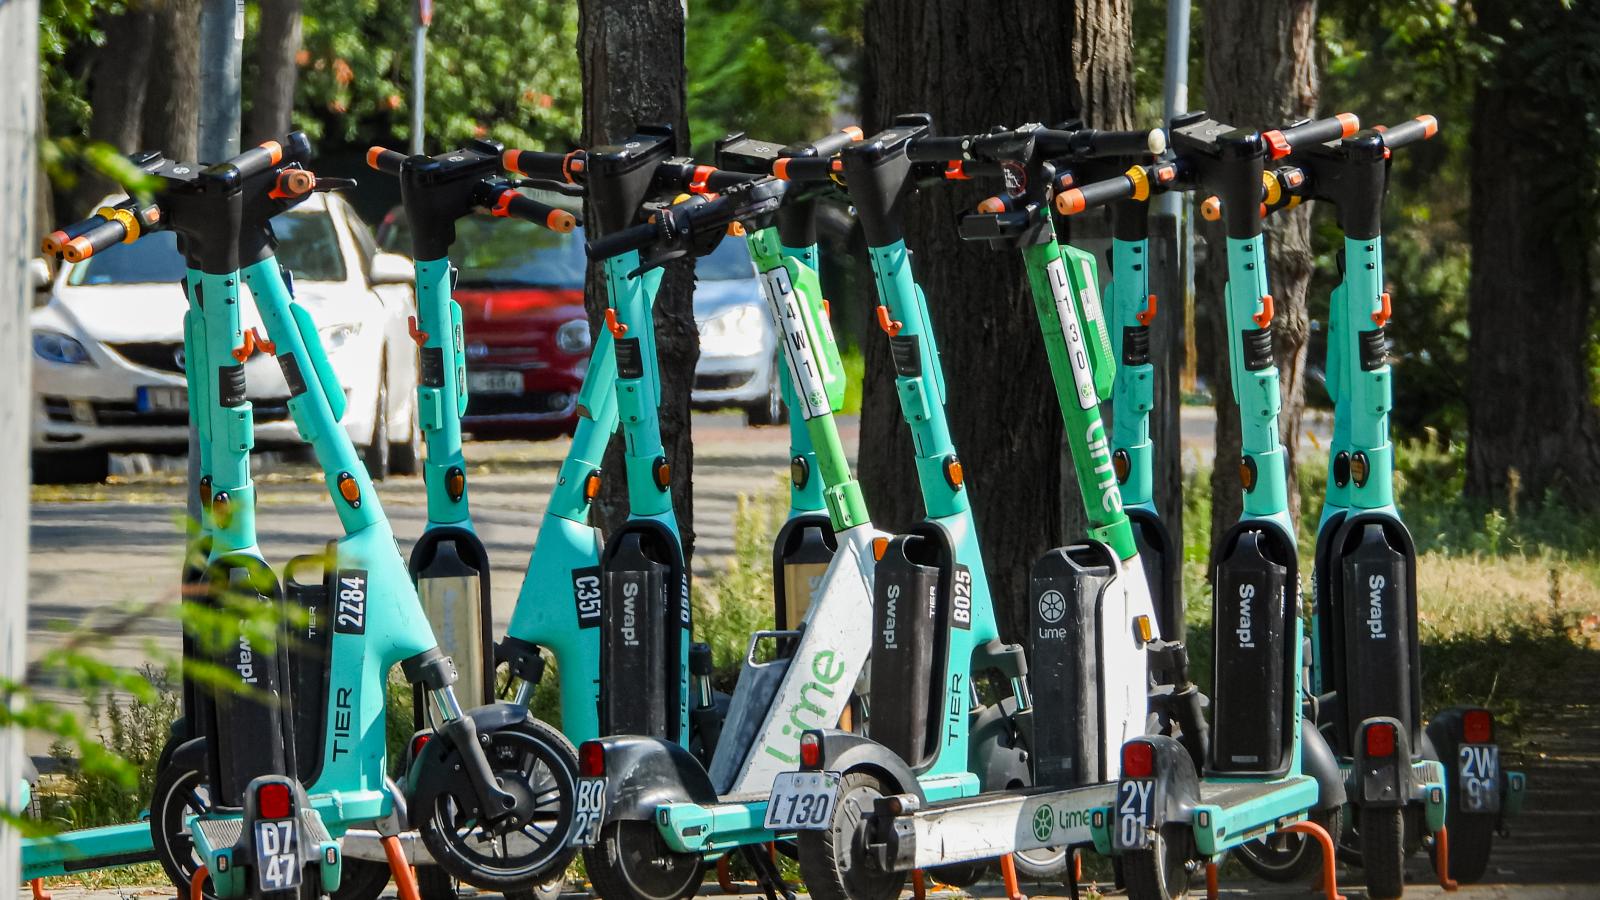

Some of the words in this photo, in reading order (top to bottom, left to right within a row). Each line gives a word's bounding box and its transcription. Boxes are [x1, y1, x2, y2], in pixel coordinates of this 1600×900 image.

[776, 276, 814, 379] L4W1
[1055, 269, 1086, 370] L130
[338, 576, 365, 628] 2Z84
[575, 575, 601, 619] C351
[621, 582, 640, 647] Swap!
[883, 584, 900, 650] Swap!
[1236, 583, 1255, 648] Swap!
[1367, 574, 1387, 640] Swap!
[308, 605, 318, 640] TIER
[1038, 627, 1067, 639] Lime
[332, 687, 353, 763] TIER
[948, 673, 963, 747] TIER
[1460, 746, 1498, 778] 2W
[769, 793, 830, 825] L130
[1120, 780, 1153, 814] 2Y
[261, 820, 293, 857] D7
[572, 812, 600, 845] 25
[266, 853, 296, 888] 47
